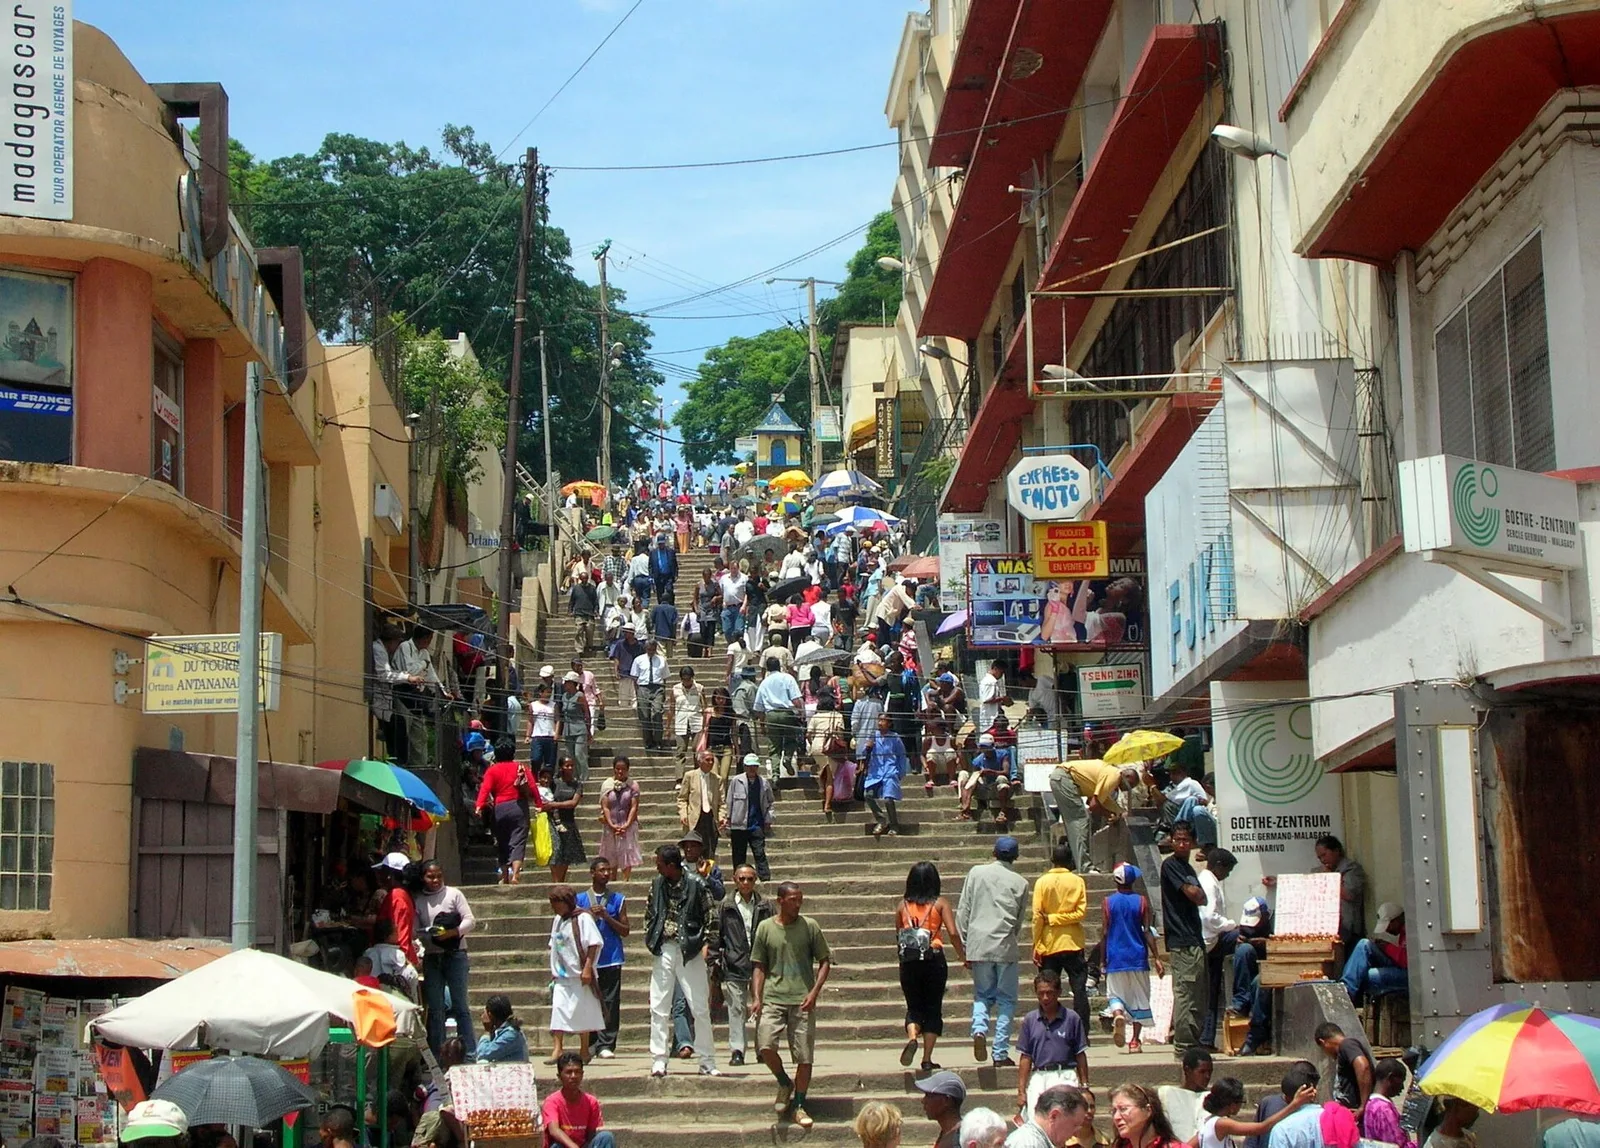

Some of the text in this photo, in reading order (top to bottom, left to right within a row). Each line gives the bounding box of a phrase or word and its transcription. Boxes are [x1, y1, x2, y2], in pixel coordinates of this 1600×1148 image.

[4, 4, 50, 203] madagascar
[53, 5, 65, 205] TOUR OPERATOR AGENCE DE VOYAGES
[0, 391, 72, 405] AIR FRANCE
[1018, 465, 1080, 485] EXPRESS
[1020, 483, 1080, 511] PHOTO
[1505, 508, 1533, 528] GOETHE
[1540, 515, 1577, 536] ZENTRUM
[1055, 528, 1086, 538] PRODUITS
[1506, 528, 1524, 540] CERCLE
[1043, 541, 1101, 558] Kodak
[1053, 562, 1062, 571] EN
[1063, 562, 1082, 571] VENTE
[184, 660, 199, 673] DU
[148, 682, 174, 693] Ortana
[1231, 814, 1331, 830] GOETHE-ZENTRUM
[1231, 833, 1256, 842] CERCLE
[1231, 844, 1285, 853] ANTANANARIVO
